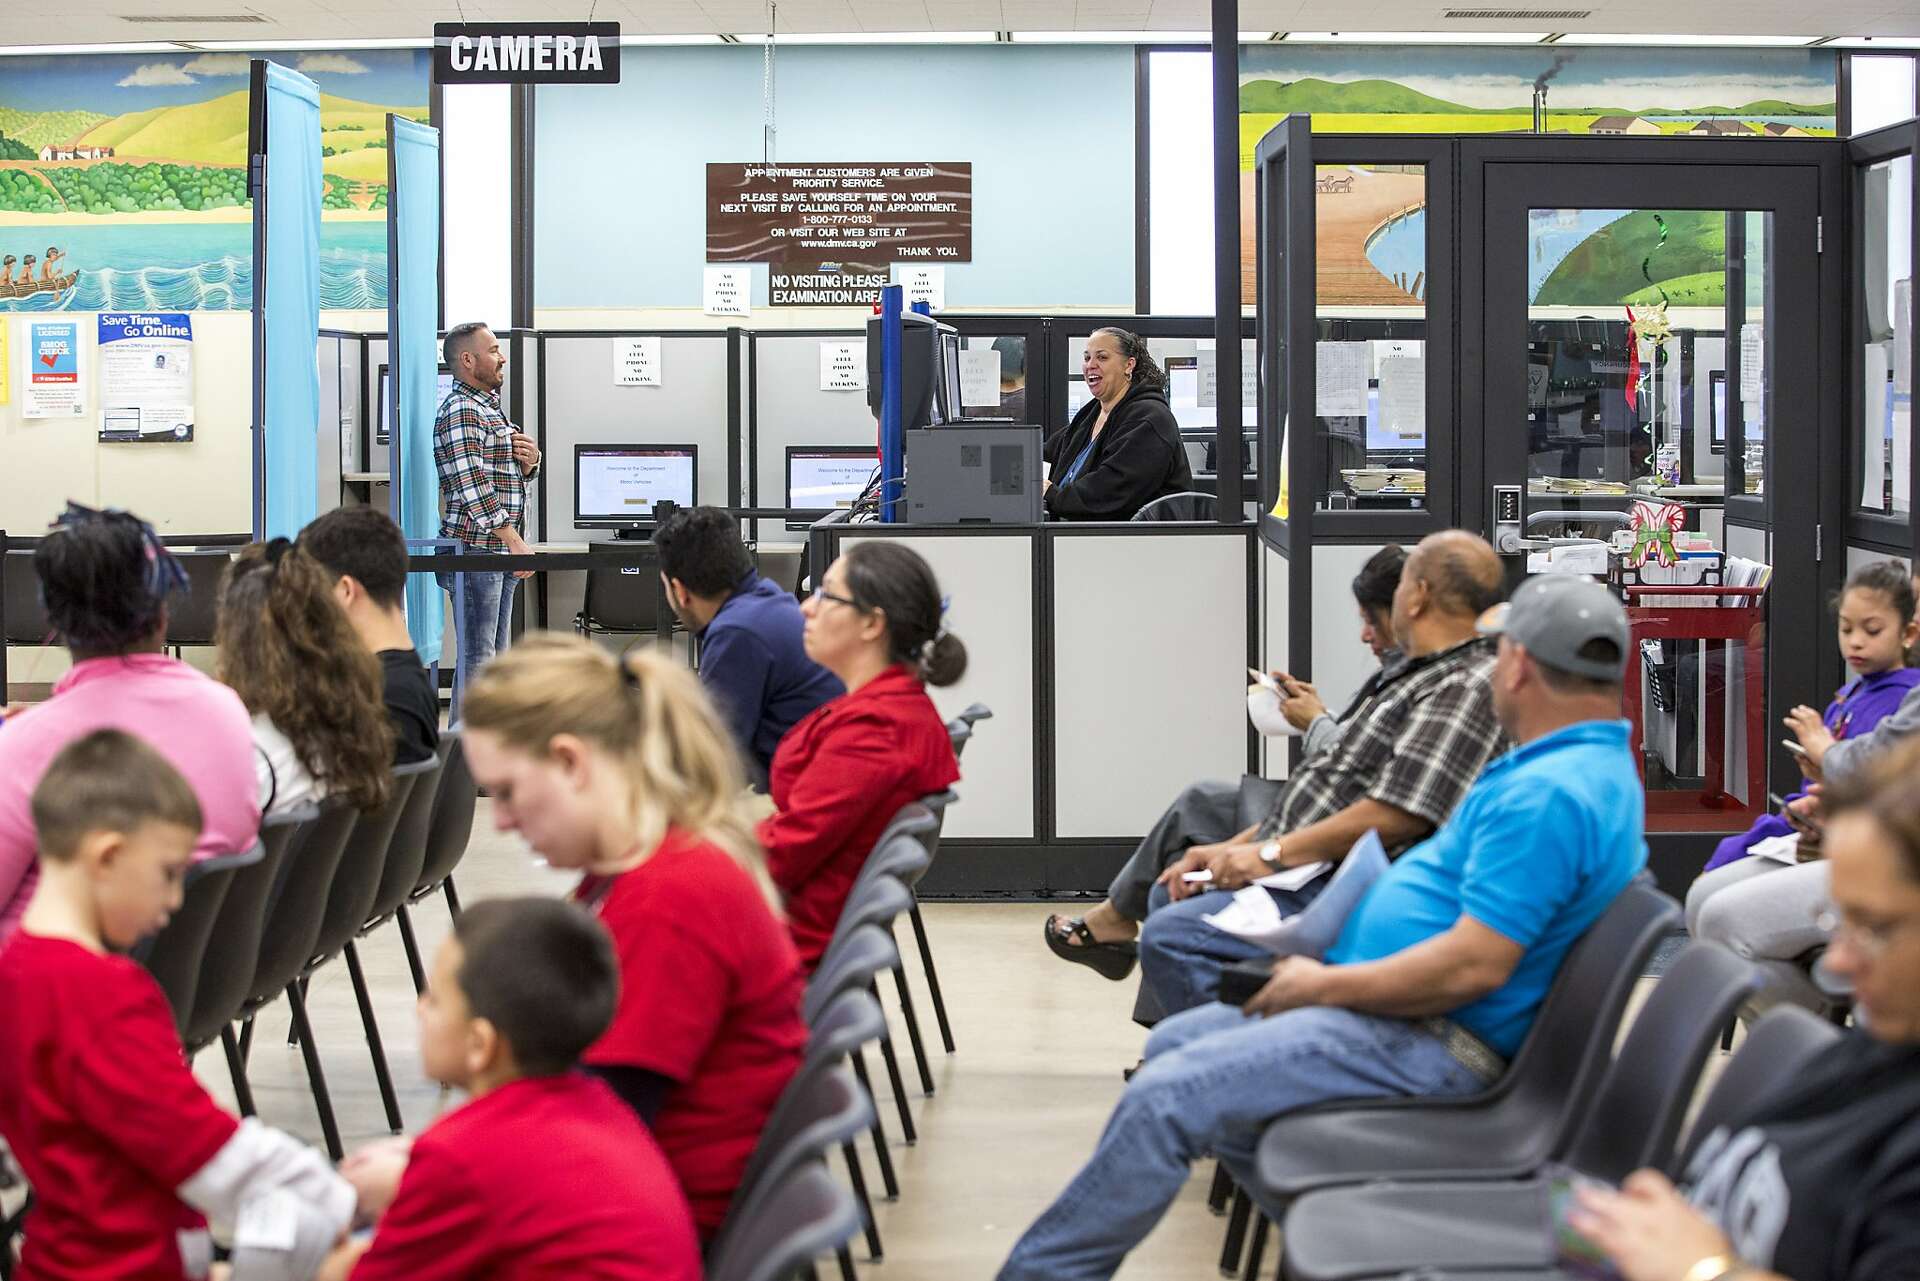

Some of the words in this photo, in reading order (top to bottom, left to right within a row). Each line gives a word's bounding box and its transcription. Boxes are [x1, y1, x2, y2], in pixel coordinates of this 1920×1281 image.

[450, 35, 604, 72] CAMERA
[816, 168, 876, 177] CUSTOMERS
[880, 168, 900, 177] ARE
[904, 168, 934, 177] GIVEN
[792, 178, 838, 188] PRIORITY
[842, 178, 885, 188] SERVICE.
[740, 193, 778, 202] PLEASE
[782, 193, 808, 202] SAVE
[810, 193, 861, 202] YOURSELF
[866, 193, 888, 202] TIME
[891, 193, 906, 202] ON
[910, 193, 937, 202] YOUR
[720, 204, 748, 212] NEXT
[752, 204, 777, 212] VISIT
[780, 204, 794, 212] BY
[798, 204, 840, 212] CALLING
[844, 204, 864, 212] FOR
[868, 204, 882, 212] AN
[887, 204, 958, 212] APPOINTMENT.
[802, 215, 872, 224] 1-800-777-0133
[770, 228, 786, 237] OR
[790, 228, 814, 237] VISIT
[818, 228, 838, 237] OUR
[843, 228, 865, 237] WEB
[868, 228, 890, 237] SITE
[894, 228, 908, 237] AT
[800, 239, 876, 250] www.dmv.ca.gov
[896, 247, 932, 256] THANK
[936, 247, 958, 256] YOU.
[772, 274, 790, 288] NO
[791, 274, 842, 288] VISITING
[842, 274, 888, 288] PLEASE
[773, 290, 854, 303] EXAMINATION
[855, 290, 883, 303] ARE
[102, 315, 128, 325] Save
[124, 325, 140, 336] Go
